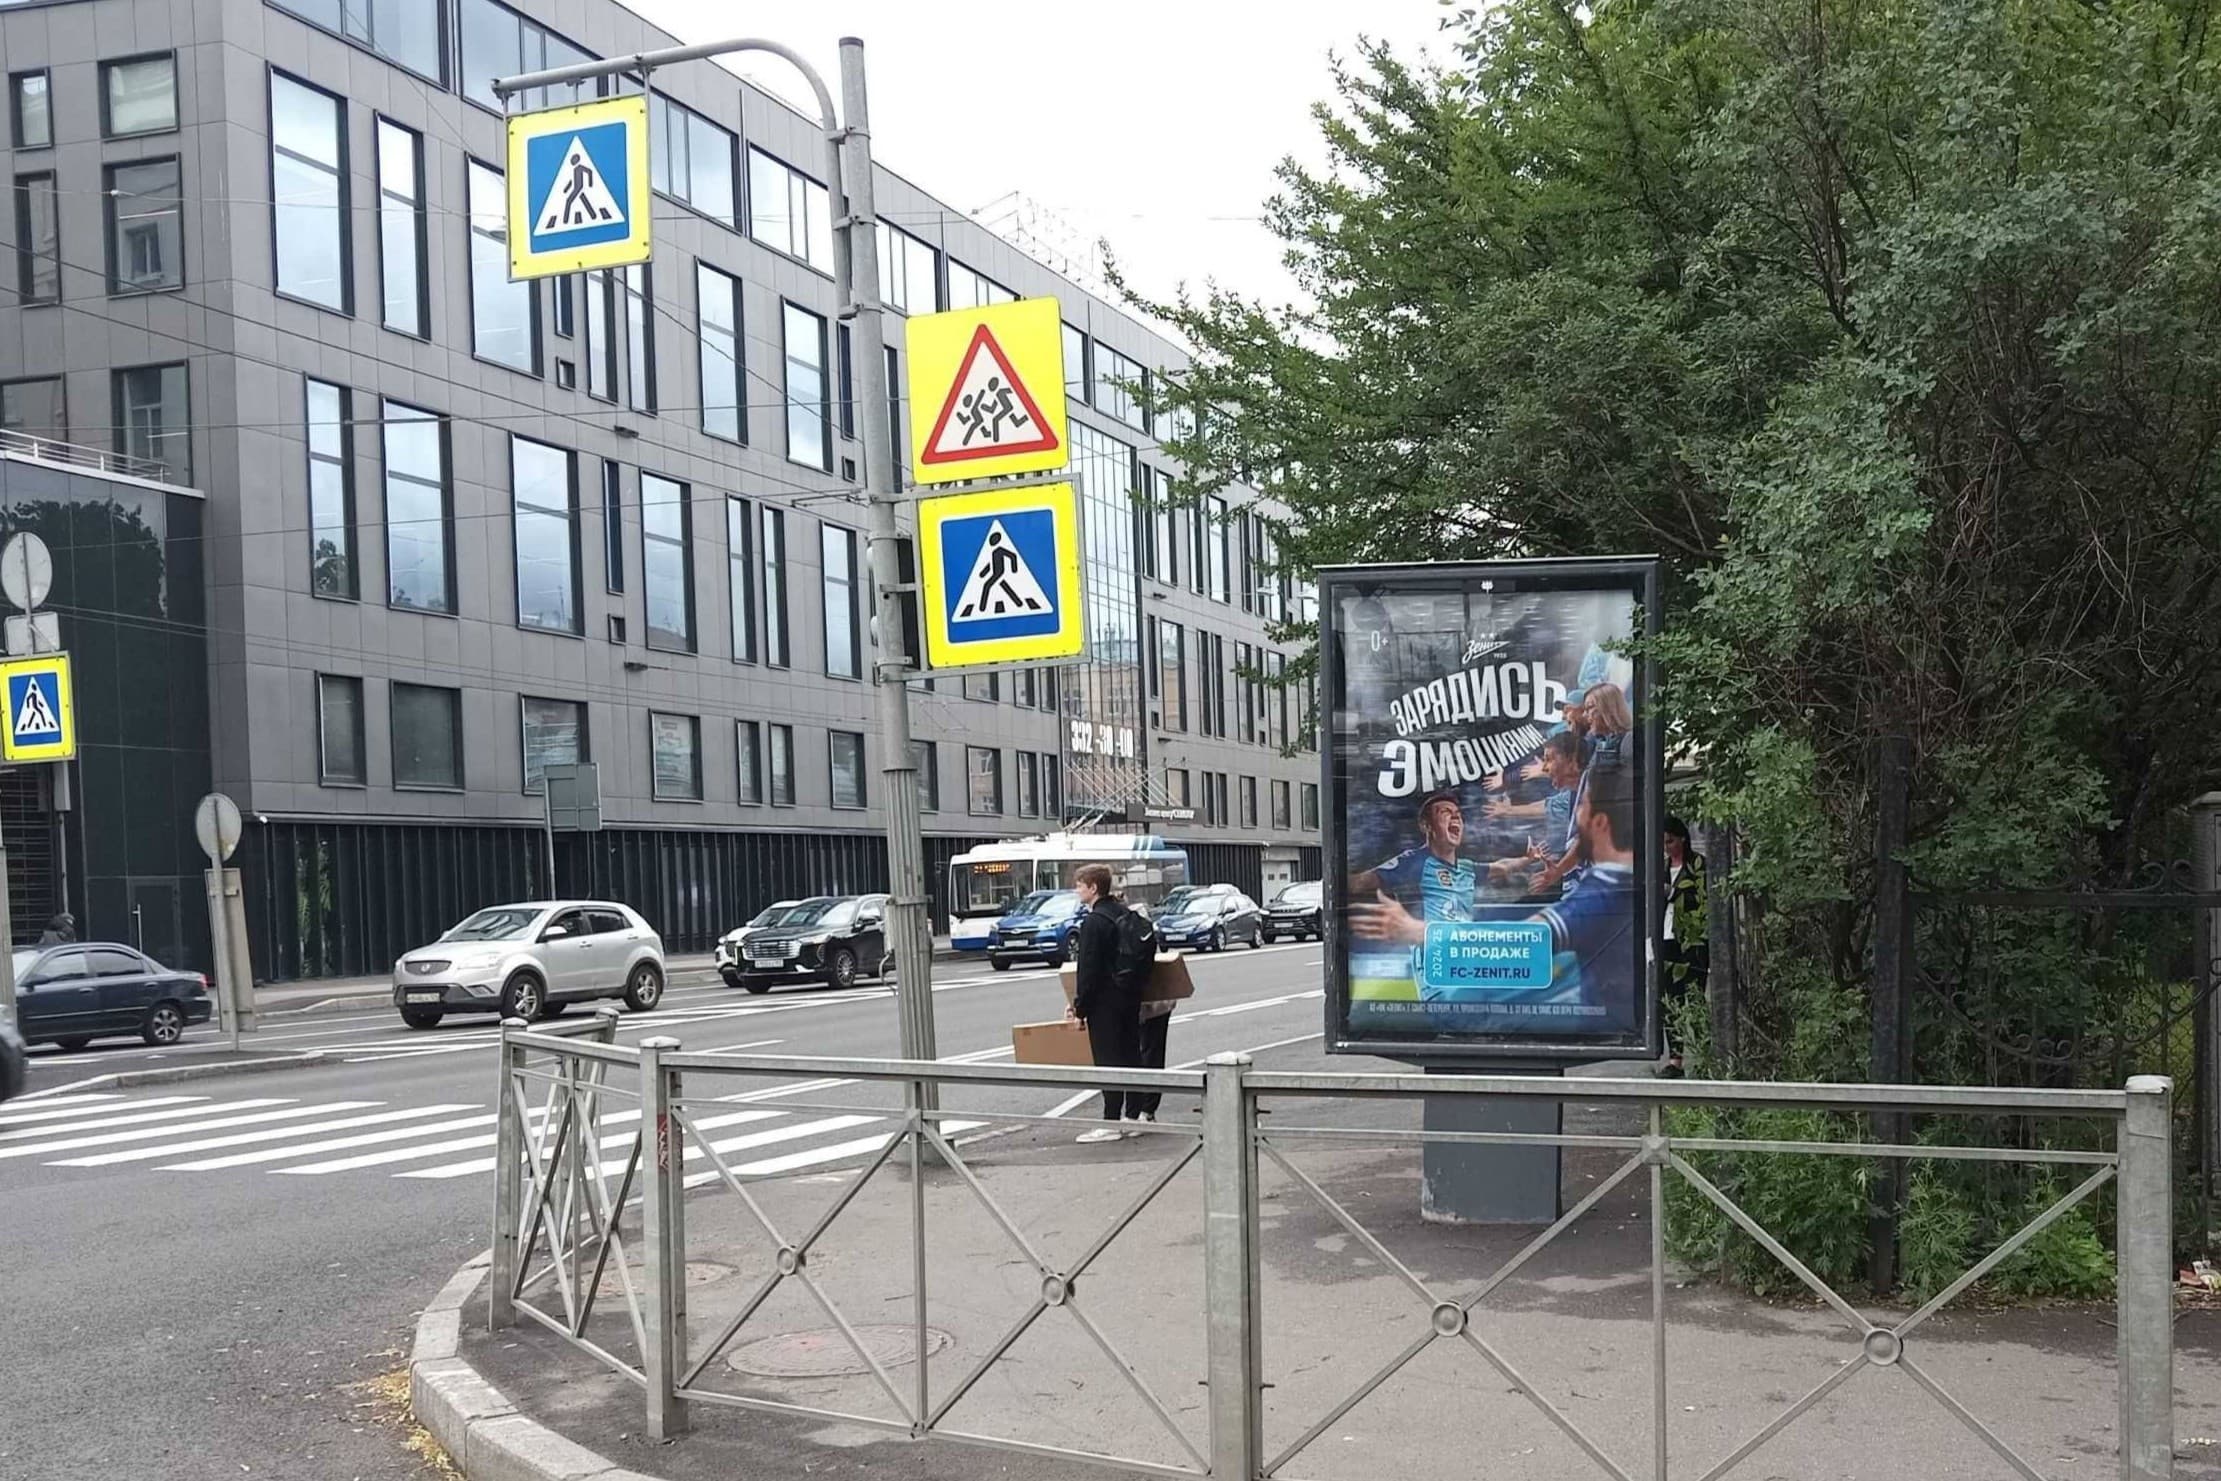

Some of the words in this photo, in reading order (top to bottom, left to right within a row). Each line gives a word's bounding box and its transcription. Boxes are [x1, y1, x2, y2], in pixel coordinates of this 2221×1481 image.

[1371, 630, 1389, 652] 0+
[1389, 661, 1567, 737] ЗАРЯДИСЬ
[1377, 723, 1548, 798] ЭМОЦИЯМИ!
[1449, 930, 1542, 943] АБОНЕМЕНТЫ
[1449, 947, 1458, 958] В
[1462, 947, 1530, 960] ПРОДАЖЕ
[1450, 967, 1531, 979] FC-ZENIT.RU
